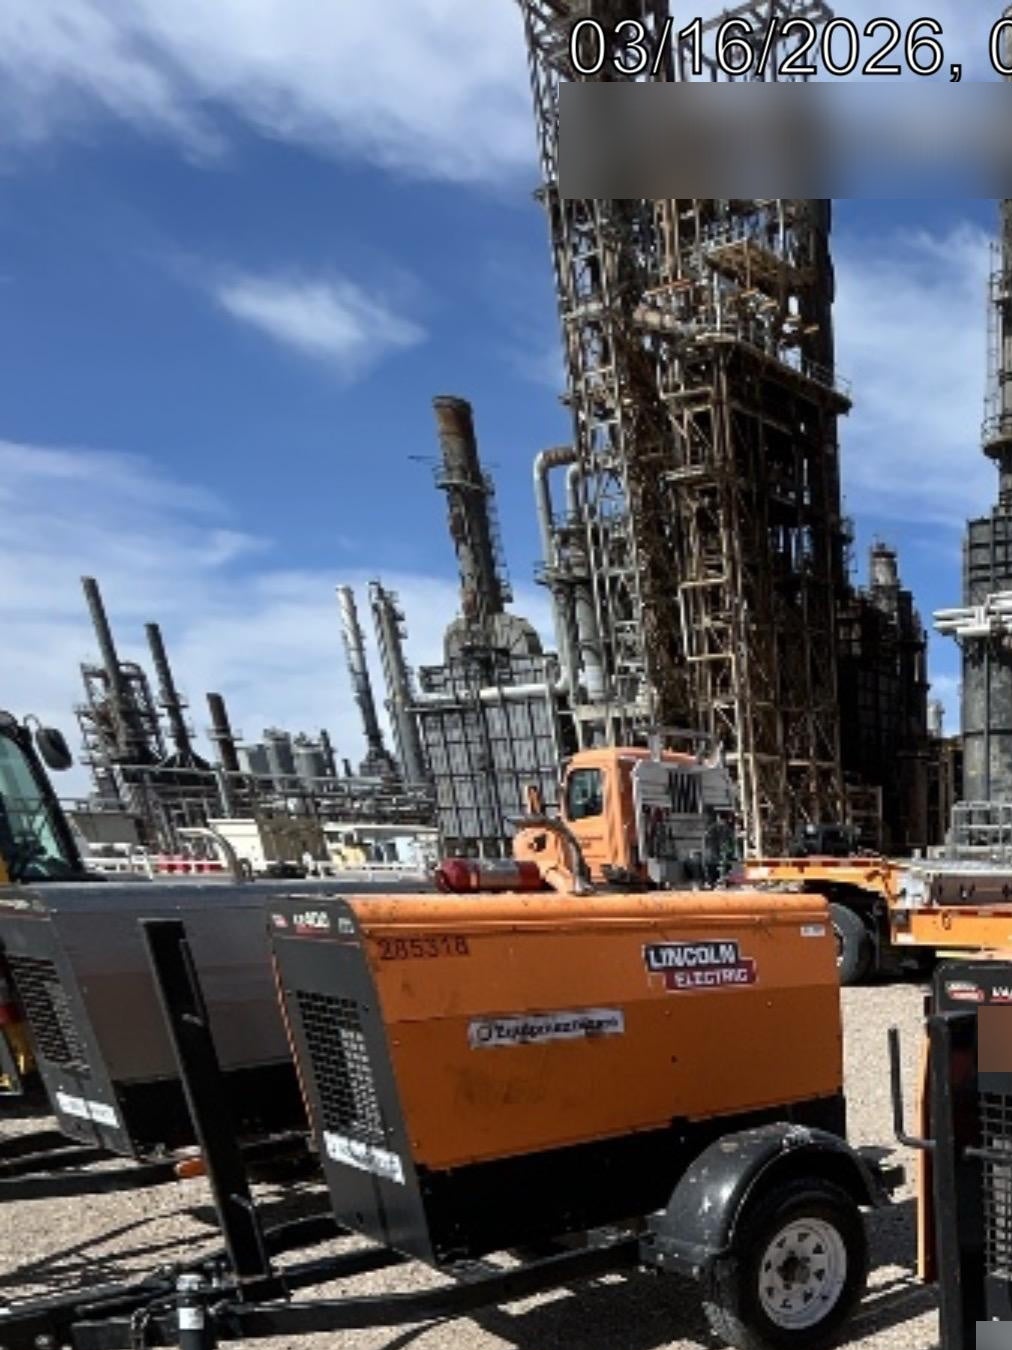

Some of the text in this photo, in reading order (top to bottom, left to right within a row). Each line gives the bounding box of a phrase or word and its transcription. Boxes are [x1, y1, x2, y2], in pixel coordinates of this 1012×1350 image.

[375, 935, 470, 961] 285318
[650, 943, 737, 969] LINCOLN
[674, 968, 748, 988] ELECTRIC
